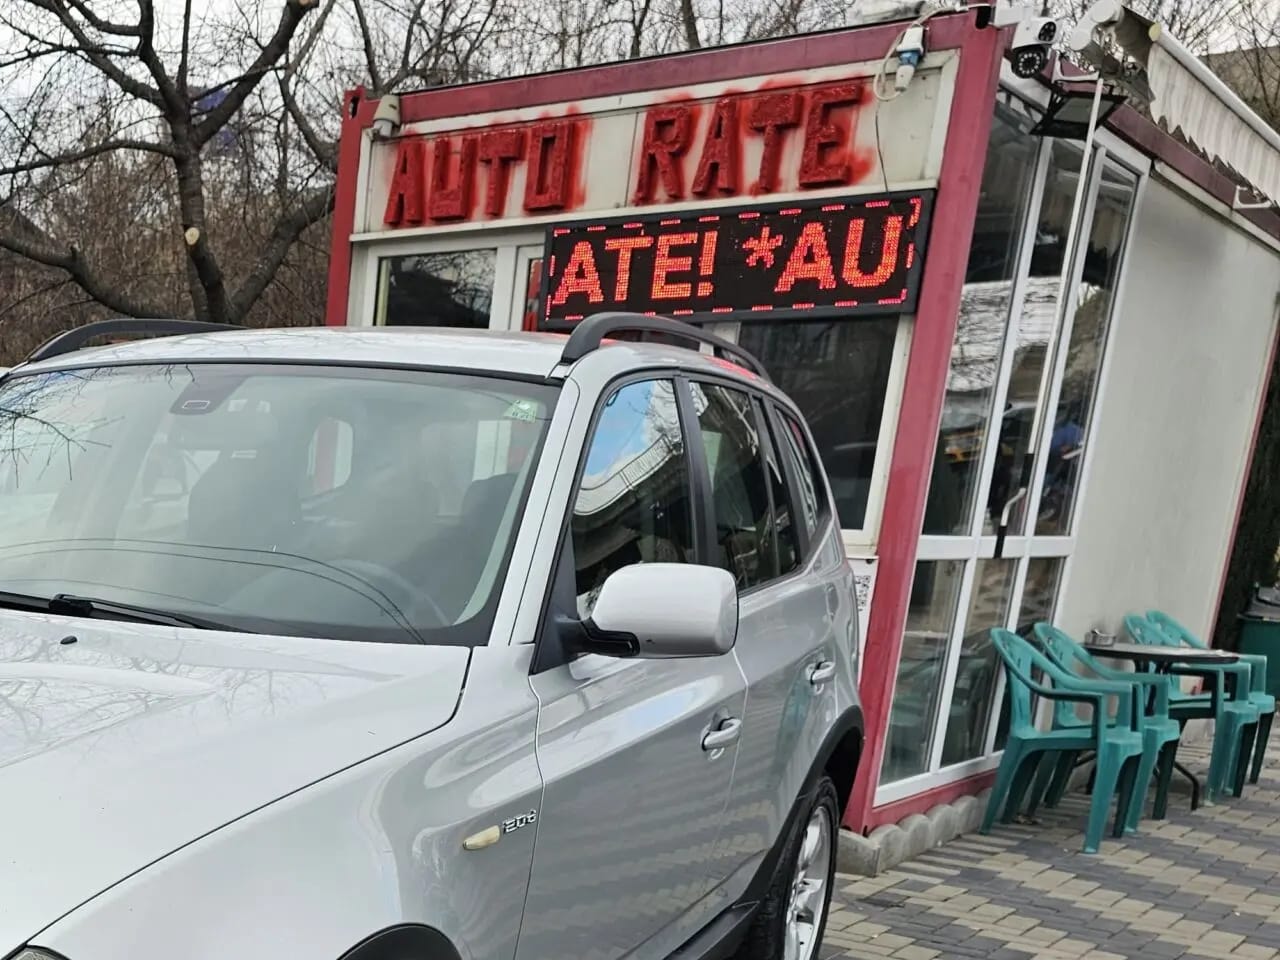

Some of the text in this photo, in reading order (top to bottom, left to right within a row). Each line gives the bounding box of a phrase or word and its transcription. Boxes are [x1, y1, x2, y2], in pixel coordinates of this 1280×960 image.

[384, 83, 866, 225] AUTO RATE
[552, 230, 718, 307] ATE!
